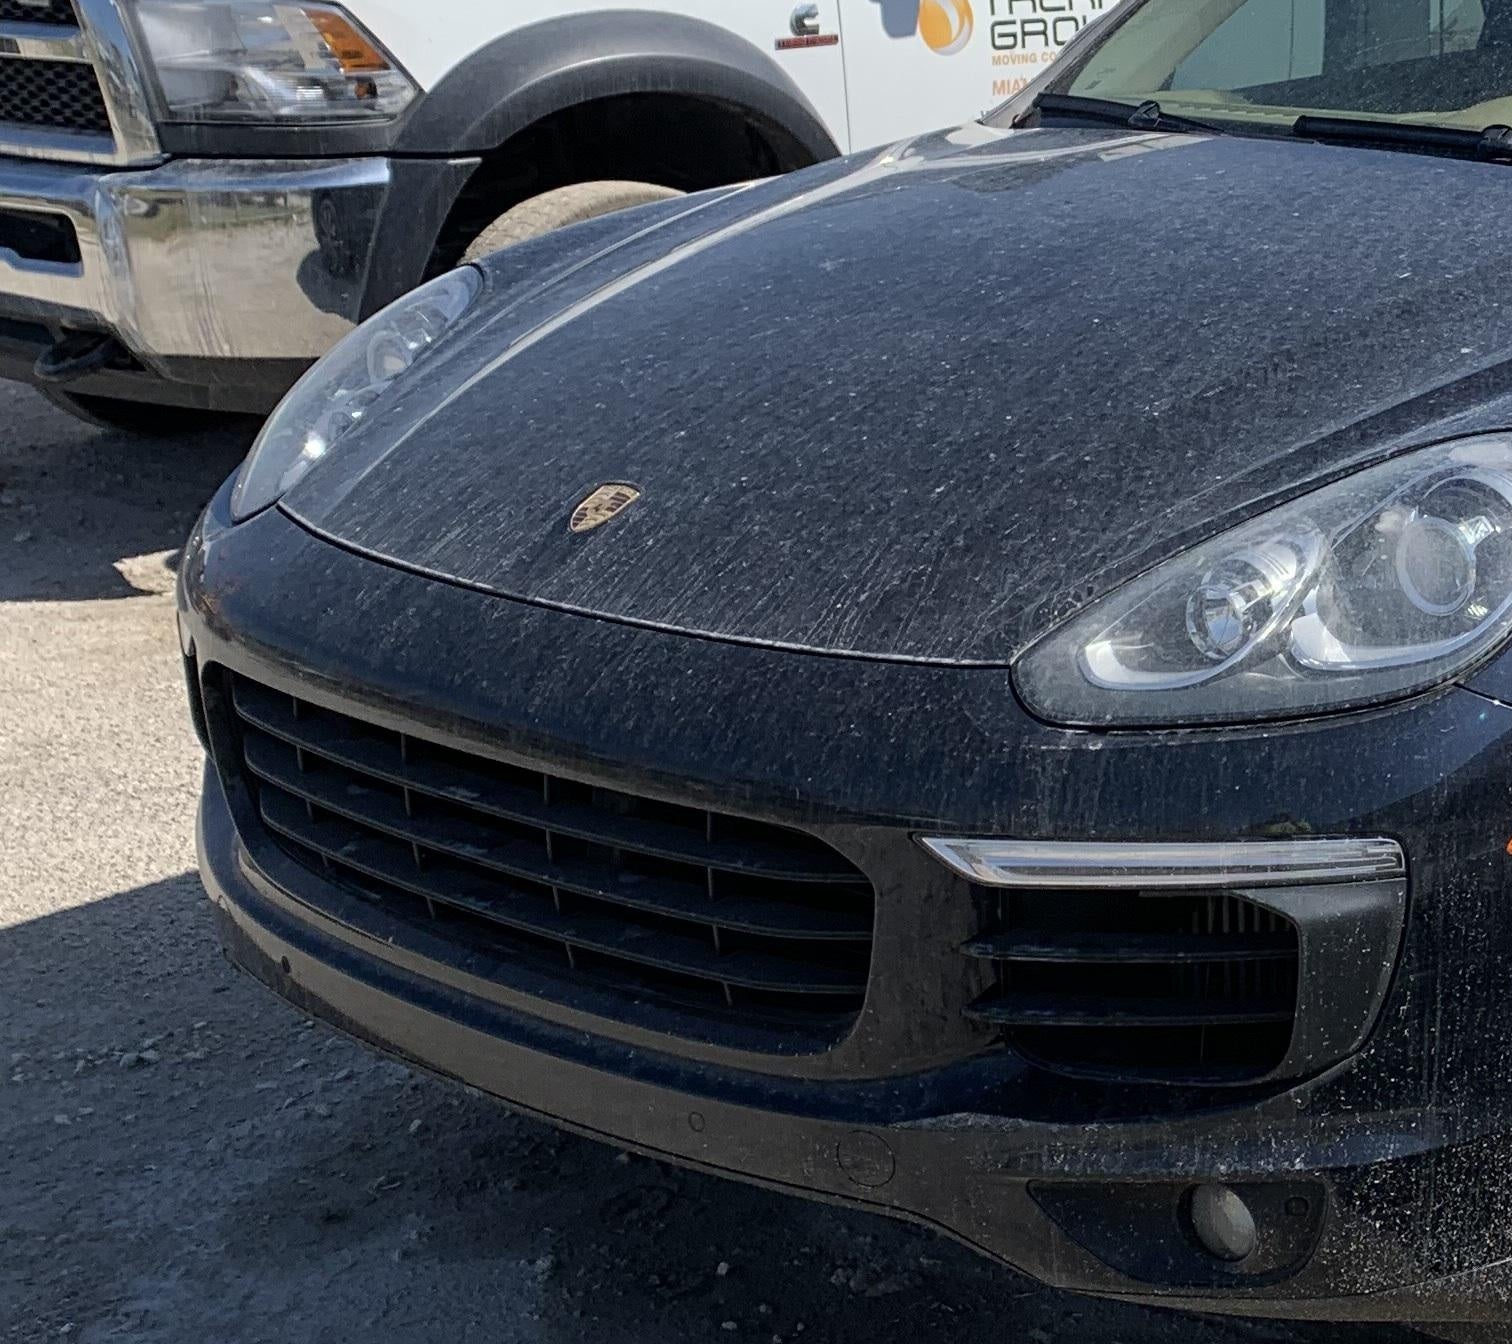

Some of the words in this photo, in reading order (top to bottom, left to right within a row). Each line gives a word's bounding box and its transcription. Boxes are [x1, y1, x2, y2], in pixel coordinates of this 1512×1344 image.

[990, 15, 1087, 51] GRO
[992, 53, 1038, 66] MOVING
[992, 78, 1029, 96] MIA
